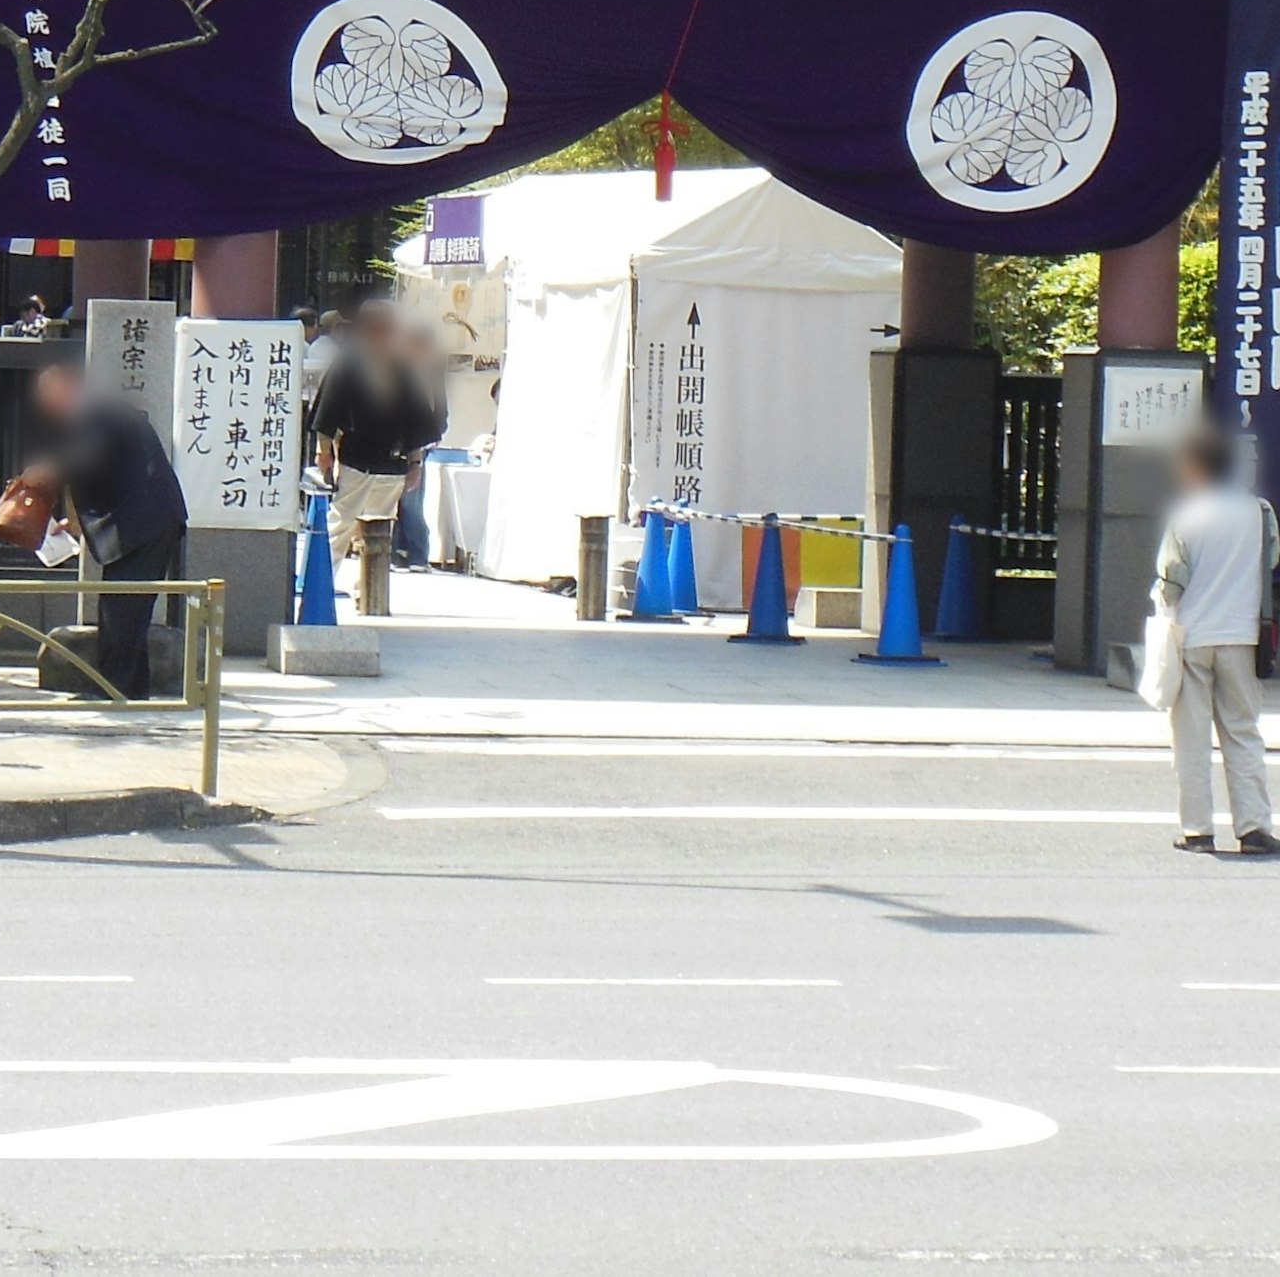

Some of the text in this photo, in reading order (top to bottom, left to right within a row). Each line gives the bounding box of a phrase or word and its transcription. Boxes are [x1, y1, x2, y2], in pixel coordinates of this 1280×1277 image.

[121, 318, 150, 414] 諸宗山
[187, 338, 220, 455] 入れません
[259, 339, 293, 508] 出開帳期間中は
[673, 343, 705, 504] 出開帳順路
